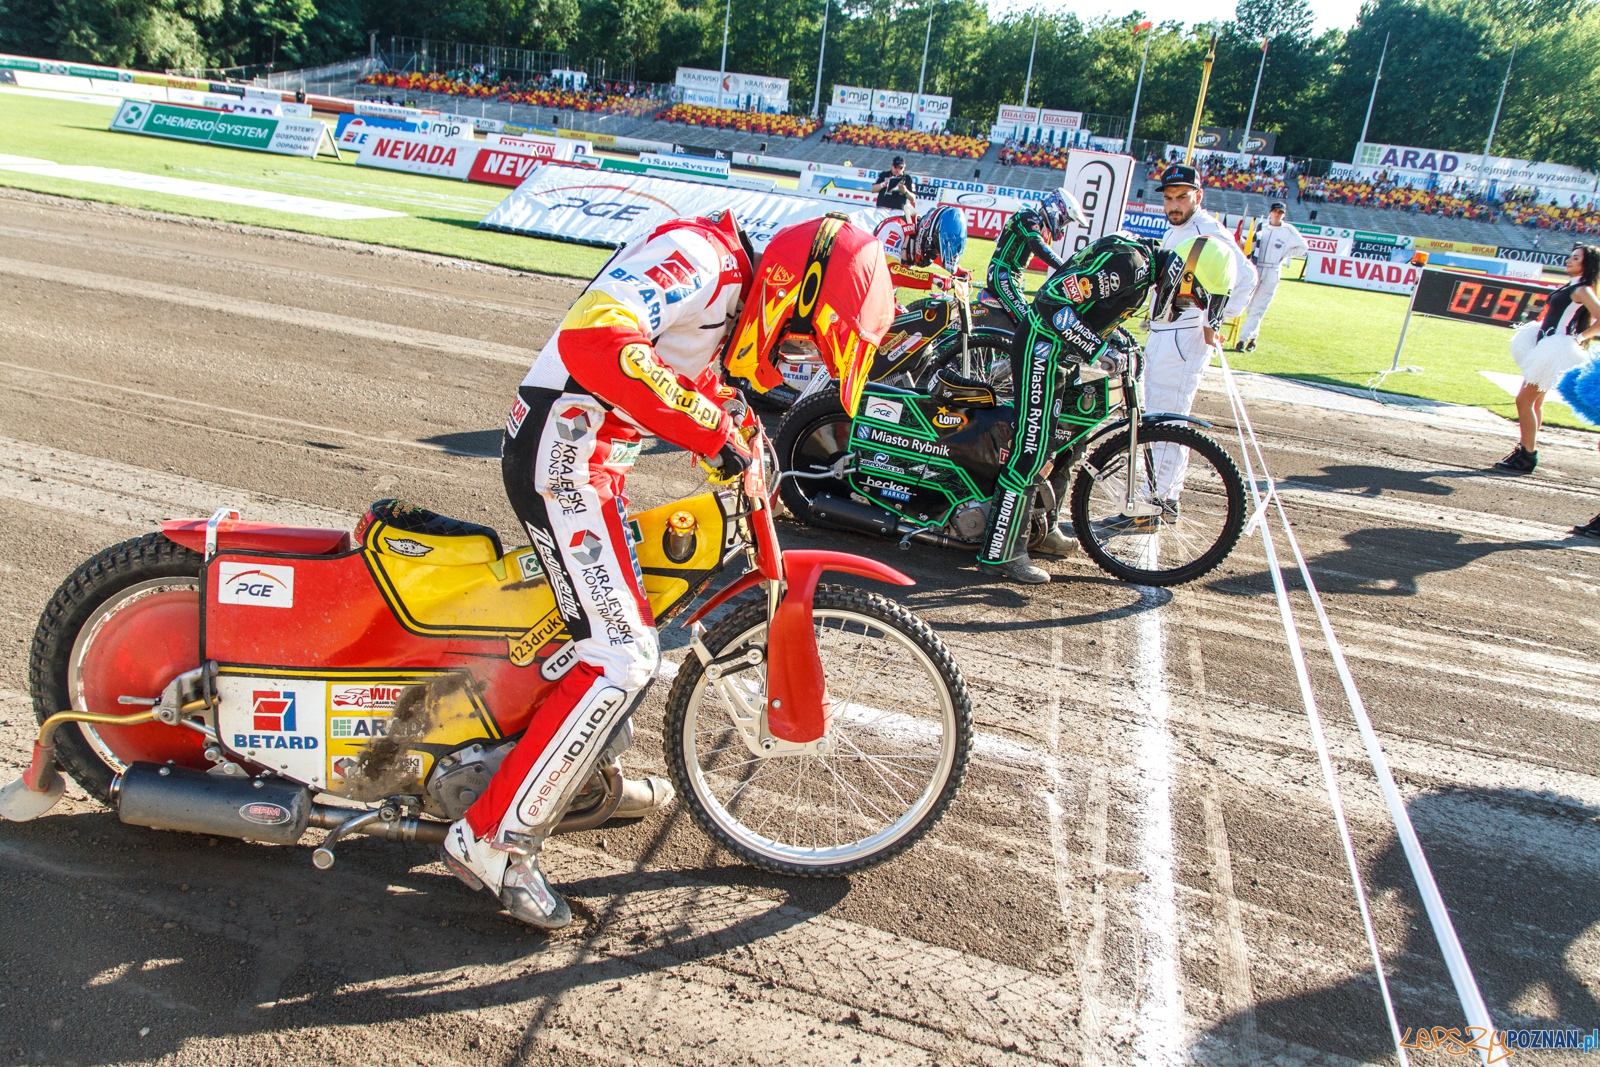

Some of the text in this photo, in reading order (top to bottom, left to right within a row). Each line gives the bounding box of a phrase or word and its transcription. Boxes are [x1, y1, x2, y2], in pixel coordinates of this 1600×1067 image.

[166, 78, 197, 88] WICAR
[682, 72, 720, 83] KRAJEWSKI
[744, 79, 782, 89] KRAJEWSKI
[698, 95, 717, 104] WORL
[848, 91, 869, 102] mjp
[888, 95, 909, 106] mjp
[927, 100, 949, 110] mjp
[453, 115, 468, 124] mjp
[481, 120, 496, 128] mjp
[1042, 114, 1079, 127] DRAGON
[152, 113, 269, 140] CHEMEKO-SYSTEM
[284, 124, 315, 133] SYSTEMY
[432, 123, 461, 138] mjp
[275, 133, 318, 143] GOSPODARKI
[993, 130, 1007, 138] THE
[1198, 136, 1216, 144] LOTTO
[275, 142, 310, 151] ODPADAMI
[372, 138, 457, 167] NEVADA
[652, 158, 725, 175] SAVI-SYSTEM
[1379, 148, 1460, 173] ARAD
[1536, 172, 1590, 185] wyzwania.
[933, 179, 984, 193] BETARD
[549, 199, 651, 223] PGE
[1073, 175, 1102, 253] TOITO
[1430, 240, 1454, 249] WICAR
[1471, 246, 1495, 254] WICAR
[1320, 257, 1417, 285] NEVADA
[1506, 269, 1538, 280] olska
[1366, 283, 1407, 292] PART
[608, 267, 661, 331] BETARD
[1071, 320, 1102, 345] Miasto
[1062, 328, 1097, 356] Rybnik
[783, 372, 809, 381] BETARD
[627, 346, 718, 425] 123drukuj.pl
[1023, 357, 1046, 454] Miasto Rybnik
[873, 407, 893, 418] PGE
[938, 414, 962, 425] LOTTO
[871, 430, 950, 458] Miasto Rybnik
[559, 444, 588, 514] KRAJEWSKI
[866, 476, 910, 493] becker
[882, 489, 910, 501] WARKOP
[615, 496, 643, 578] BETAR
[235, 582, 275, 598] PGE
[581, 567, 623, 647] KONSTRUKCJE
[593, 564, 635, 645] KRAJEWSKI
[510, 614, 565, 662] 123druku
[546, 645, 577, 674] TOIT
[369, 688, 402, 701] WIC
[353, 718, 421, 737] ARD
[234, 734, 319, 750] BETARD
[249, 805, 281, 817] GPM
